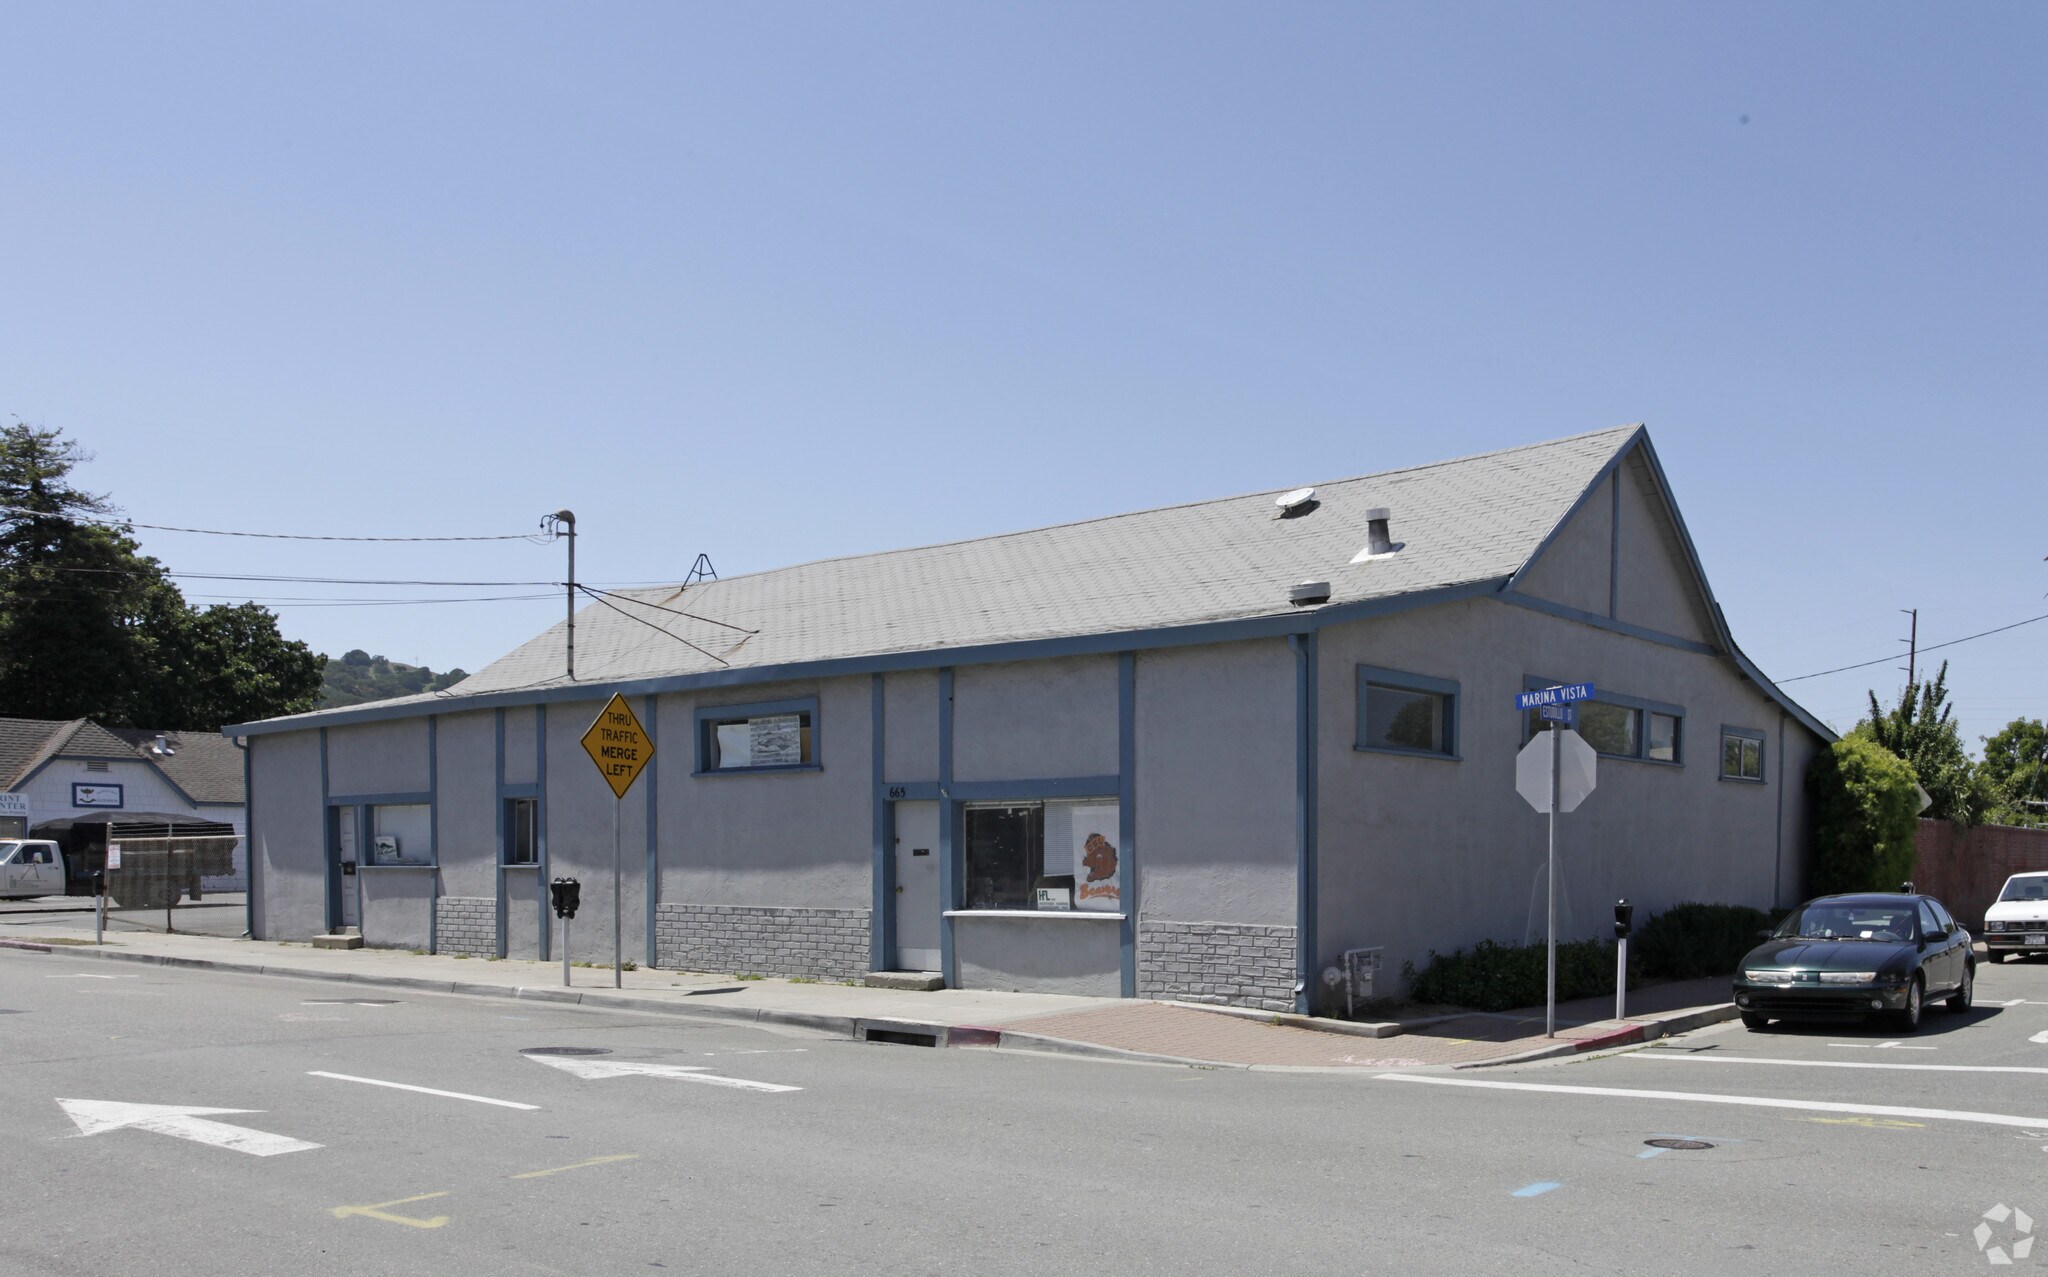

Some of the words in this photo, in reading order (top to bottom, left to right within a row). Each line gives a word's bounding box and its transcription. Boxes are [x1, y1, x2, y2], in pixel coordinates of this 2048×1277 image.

[1522, 691, 1556, 707] MARINA
[1561, 685, 1587, 700] VISTA
[608, 712, 632, 726] THRU
[601, 728, 638, 744] TRAFFIC
[601, 746, 638, 760] MERGE
[606, 764, 633, 777] LEFT
